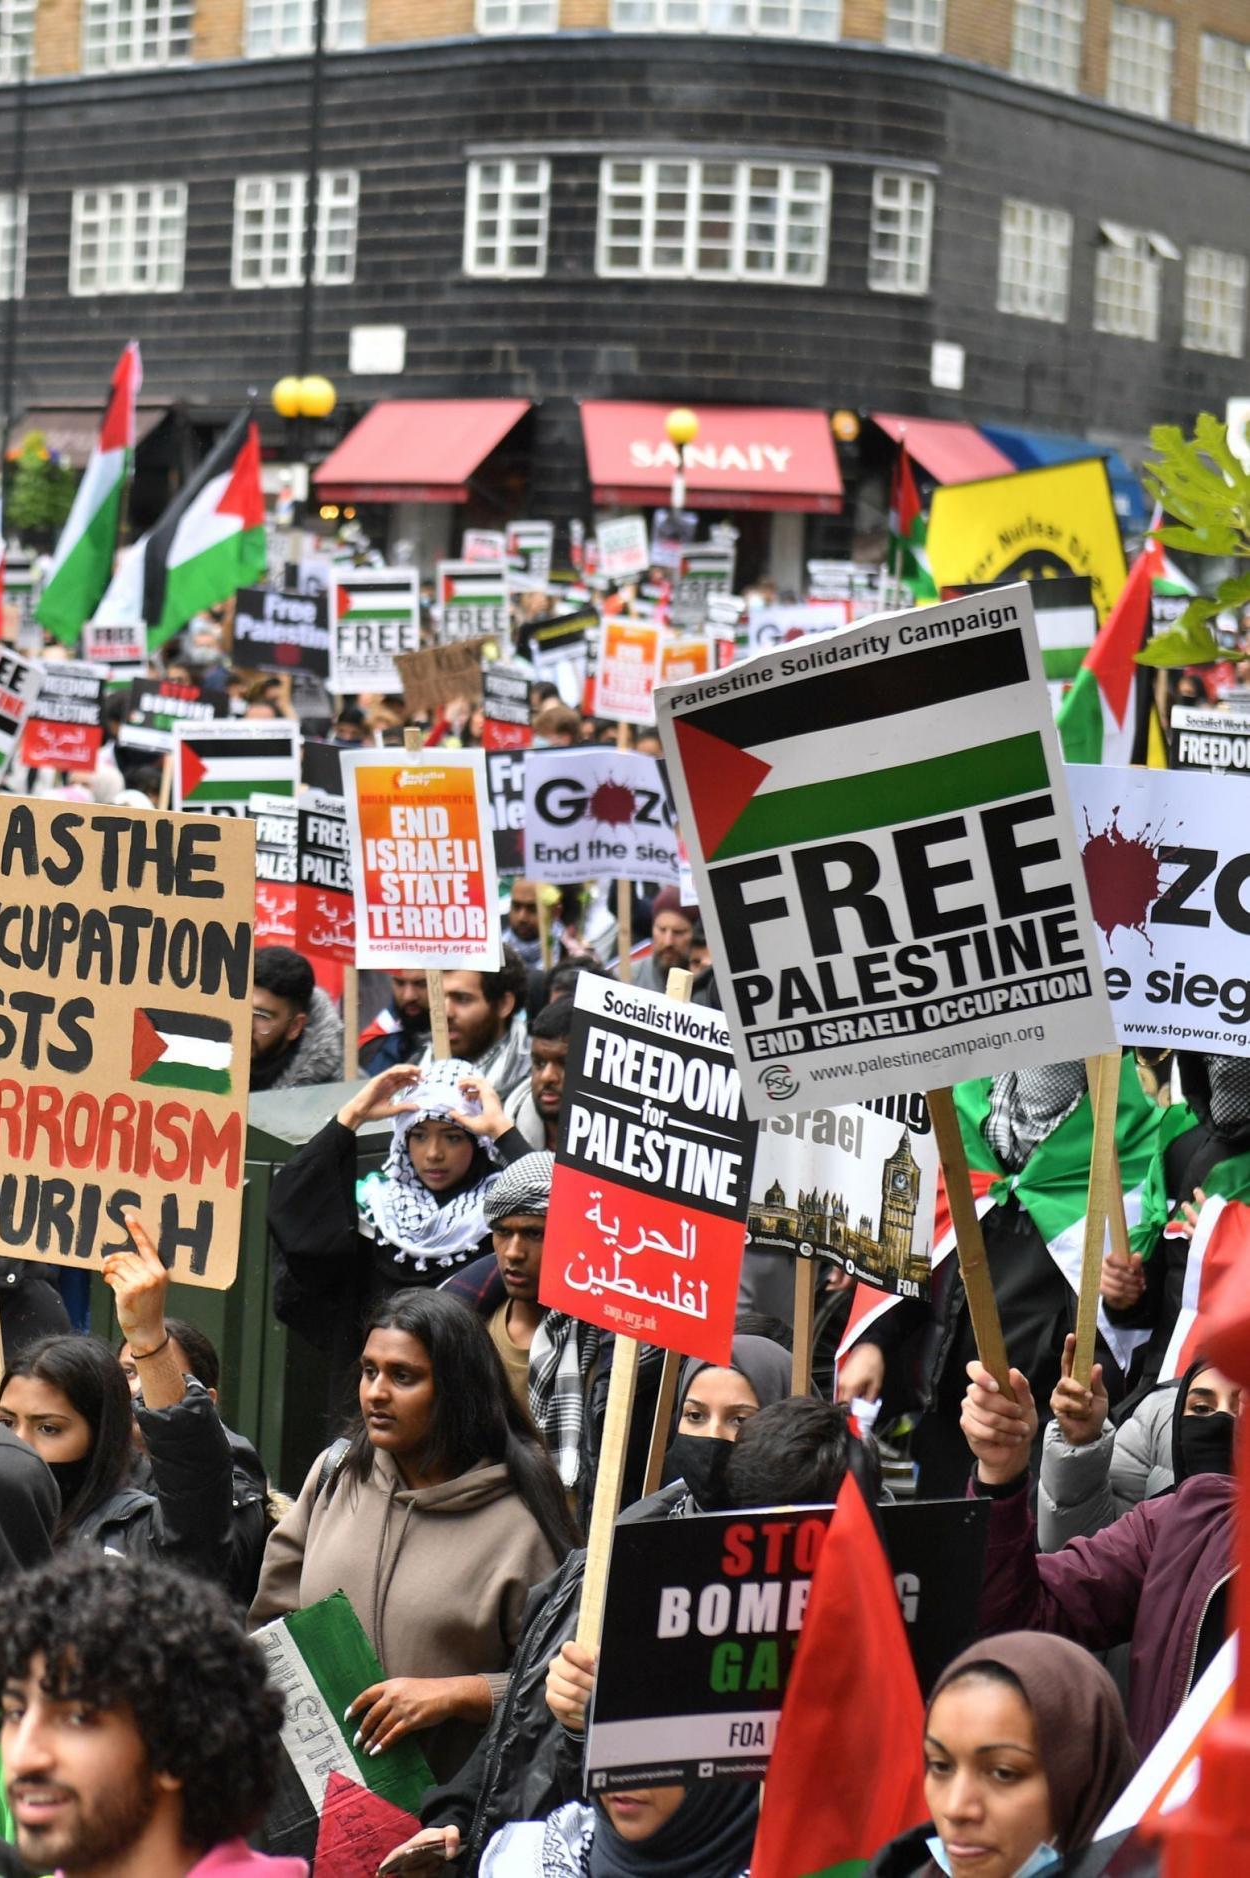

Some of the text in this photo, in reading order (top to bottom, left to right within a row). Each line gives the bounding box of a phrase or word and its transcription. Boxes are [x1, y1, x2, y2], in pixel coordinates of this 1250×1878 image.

[234, 616, 330, 649] Palestin
[337, 625, 413, 653] FREE
[337, 654, 393, 668] PALES
[670, 663, 775, 711] Palestine
[779, 632, 892, 681] Solidarity
[898, 603, 1019, 647] Campaign
[1179, 733, 1250, 769] FREEDO
[489, 756, 526, 793] Fr
[390, 804, 450, 839] END
[535, 778, 675, 831] Gz
[256, 815, 298, 845] FREE
[306, 816, 351, 851] FREE
[1, 804, 85, 888] AS
[89, 816, 225, 899] THE
[365, 838, 478, 872] ISRAELI
[534, 839, 679, 872] End the sie
[301, 853, 353, 892] PALES
[380, 872, 470, 905] STATE
[707, 793, 1078, 975] FREE
[368, 904, 487, 939] TERROR
[369, 942, 487, 955] socialistparty.org.uk
[731, 909, 1086, 1028] PALESTINE
[1145, 963, 1250, 1025] sieg
[603, 989, 732, 1048] Socialist Worke
[749, 1023, 807, 1060] END
[811, 1005, 918, 1052] ISRAELI
[926, 970, 1090, 1031] OCCUPATION
[810, 1023, 1046, 1083] www.palestinecampaign.org
[1124, 1023, 1250, 1046] www.stopwar.org.
[582, 1025, 741, 1122] FREEDOM
[640, 1097, 669, 1129] for
[566, 1103, 744, 1207] PALESTINE
[584, 1191, 698, 1262] الحرية
[563, 1249, 709, 1321] لفلسطين
[896, 1278, 920, 1298] FOA
[602, 1301, 658, 1334] swp.org.uk
[720, 1518, 831, 1578] STO
[657, 1571, 921, 1640] BOMBG
[709, 1640, 797, 1694] GA
[729, 1721, 765, 1748] FOA
